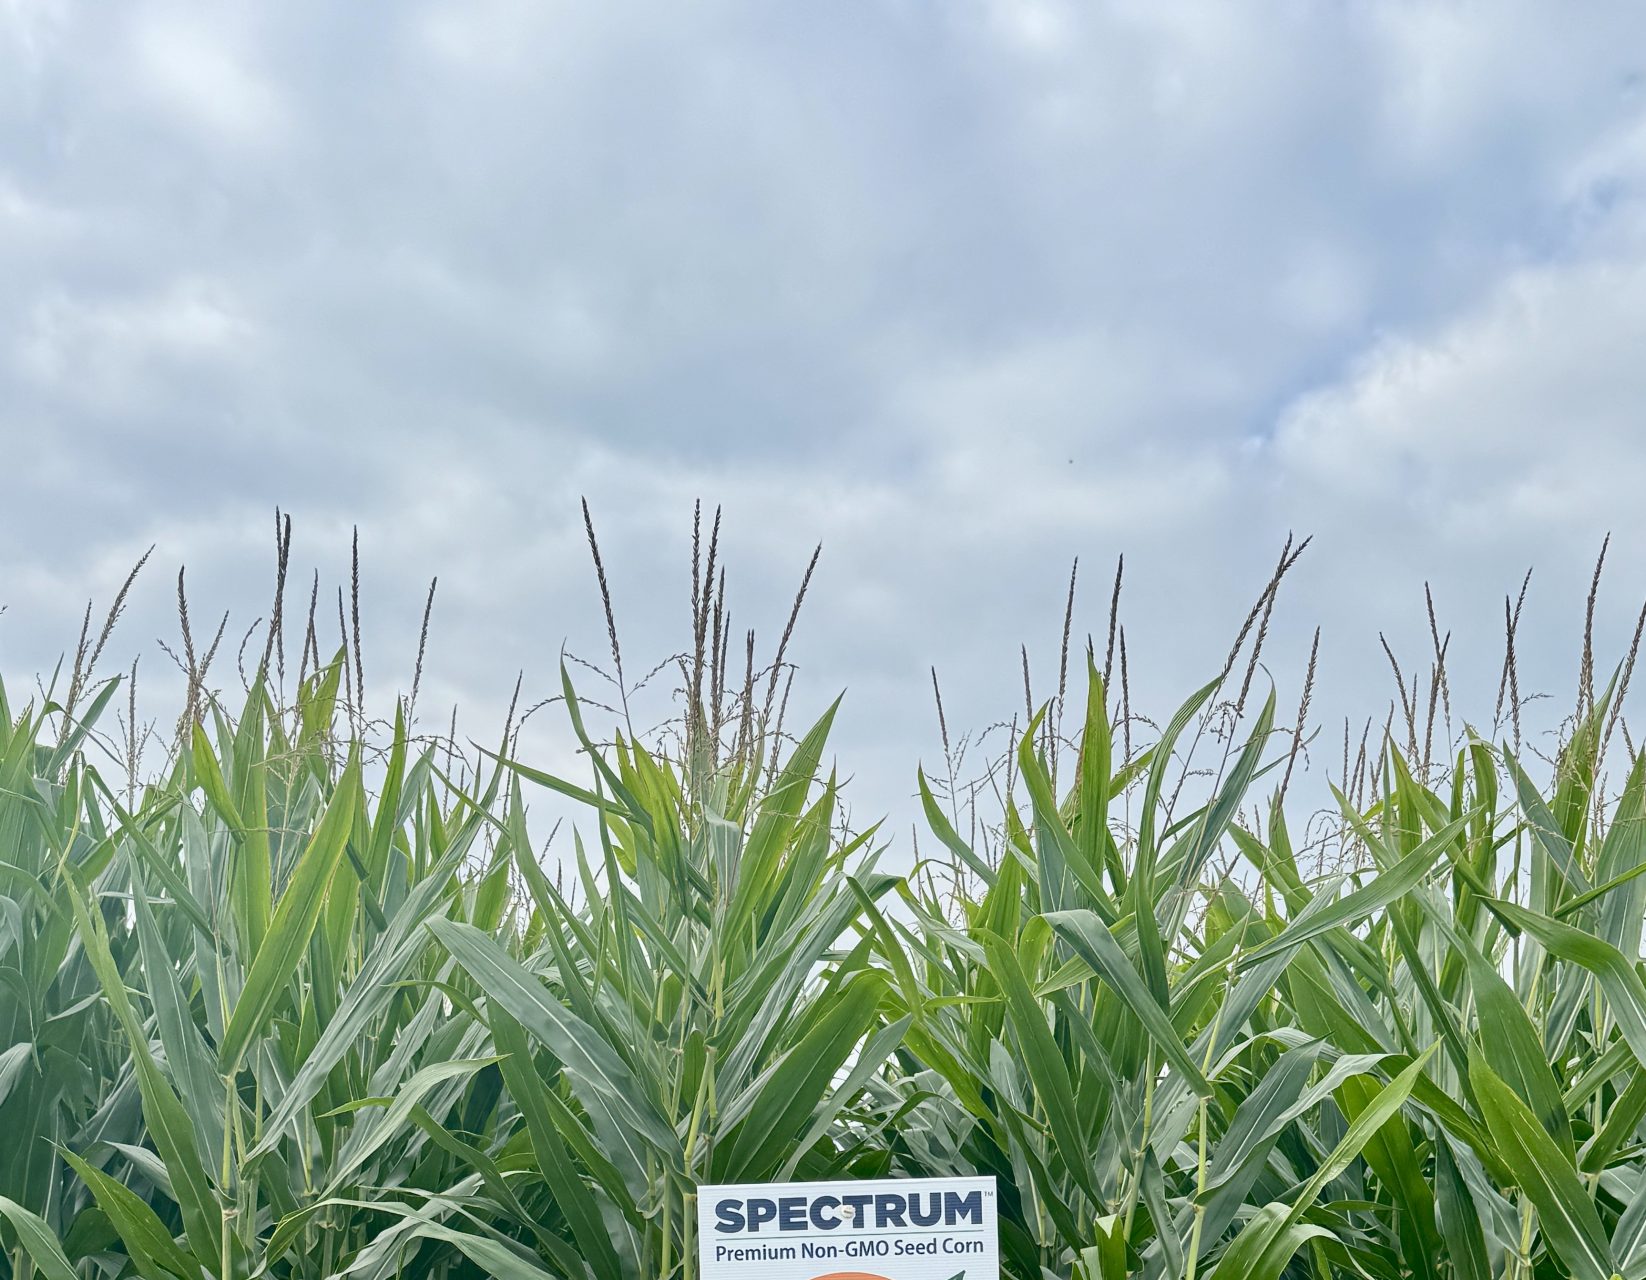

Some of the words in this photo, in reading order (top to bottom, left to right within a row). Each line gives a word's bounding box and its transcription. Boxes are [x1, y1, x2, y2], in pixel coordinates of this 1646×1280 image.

[714, 1190, 983, 1234] SPECTRUM
[716, 1244, 796, 1262] Premium
[802, 1239, 889, 1259] Non-GMO
[894, 1237, 937, 1256] Seed
[943, 1238, 984, 1254] Corn
